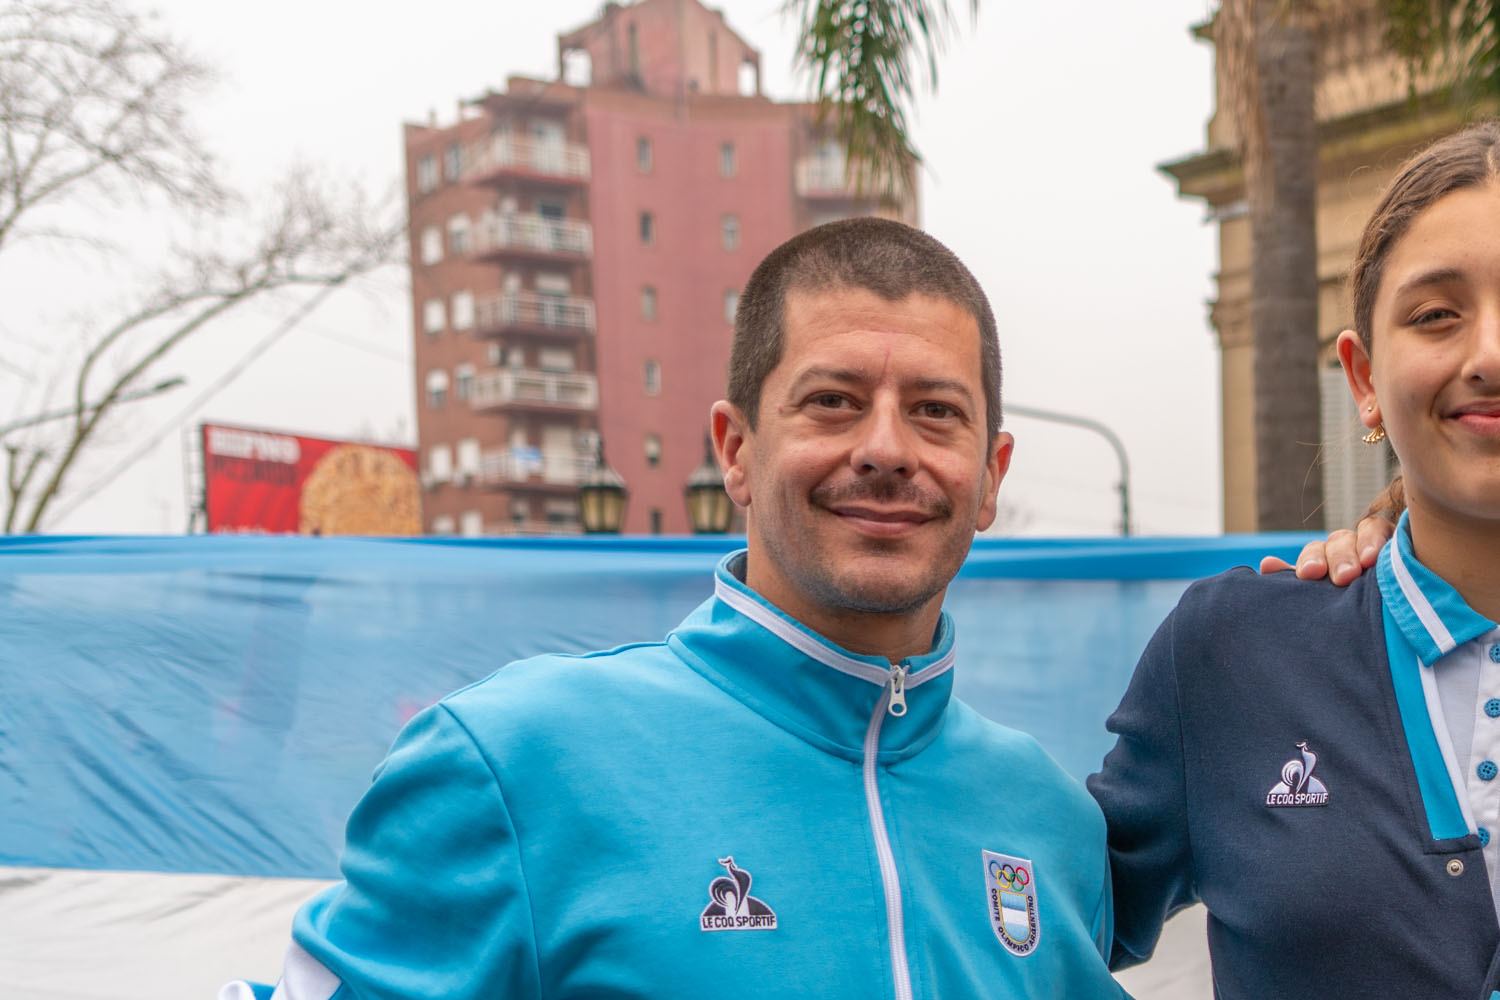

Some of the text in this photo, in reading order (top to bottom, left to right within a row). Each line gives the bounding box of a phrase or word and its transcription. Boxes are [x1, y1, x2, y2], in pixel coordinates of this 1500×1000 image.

[1266, 792, 1329, 805] LE COQ SPORTIF
[702, 915, 776, 928] LE COQ SPORTIF
[991, 888, 1001, 922] COMITE
[998, 926, 1029, 952] OLIMPICO
